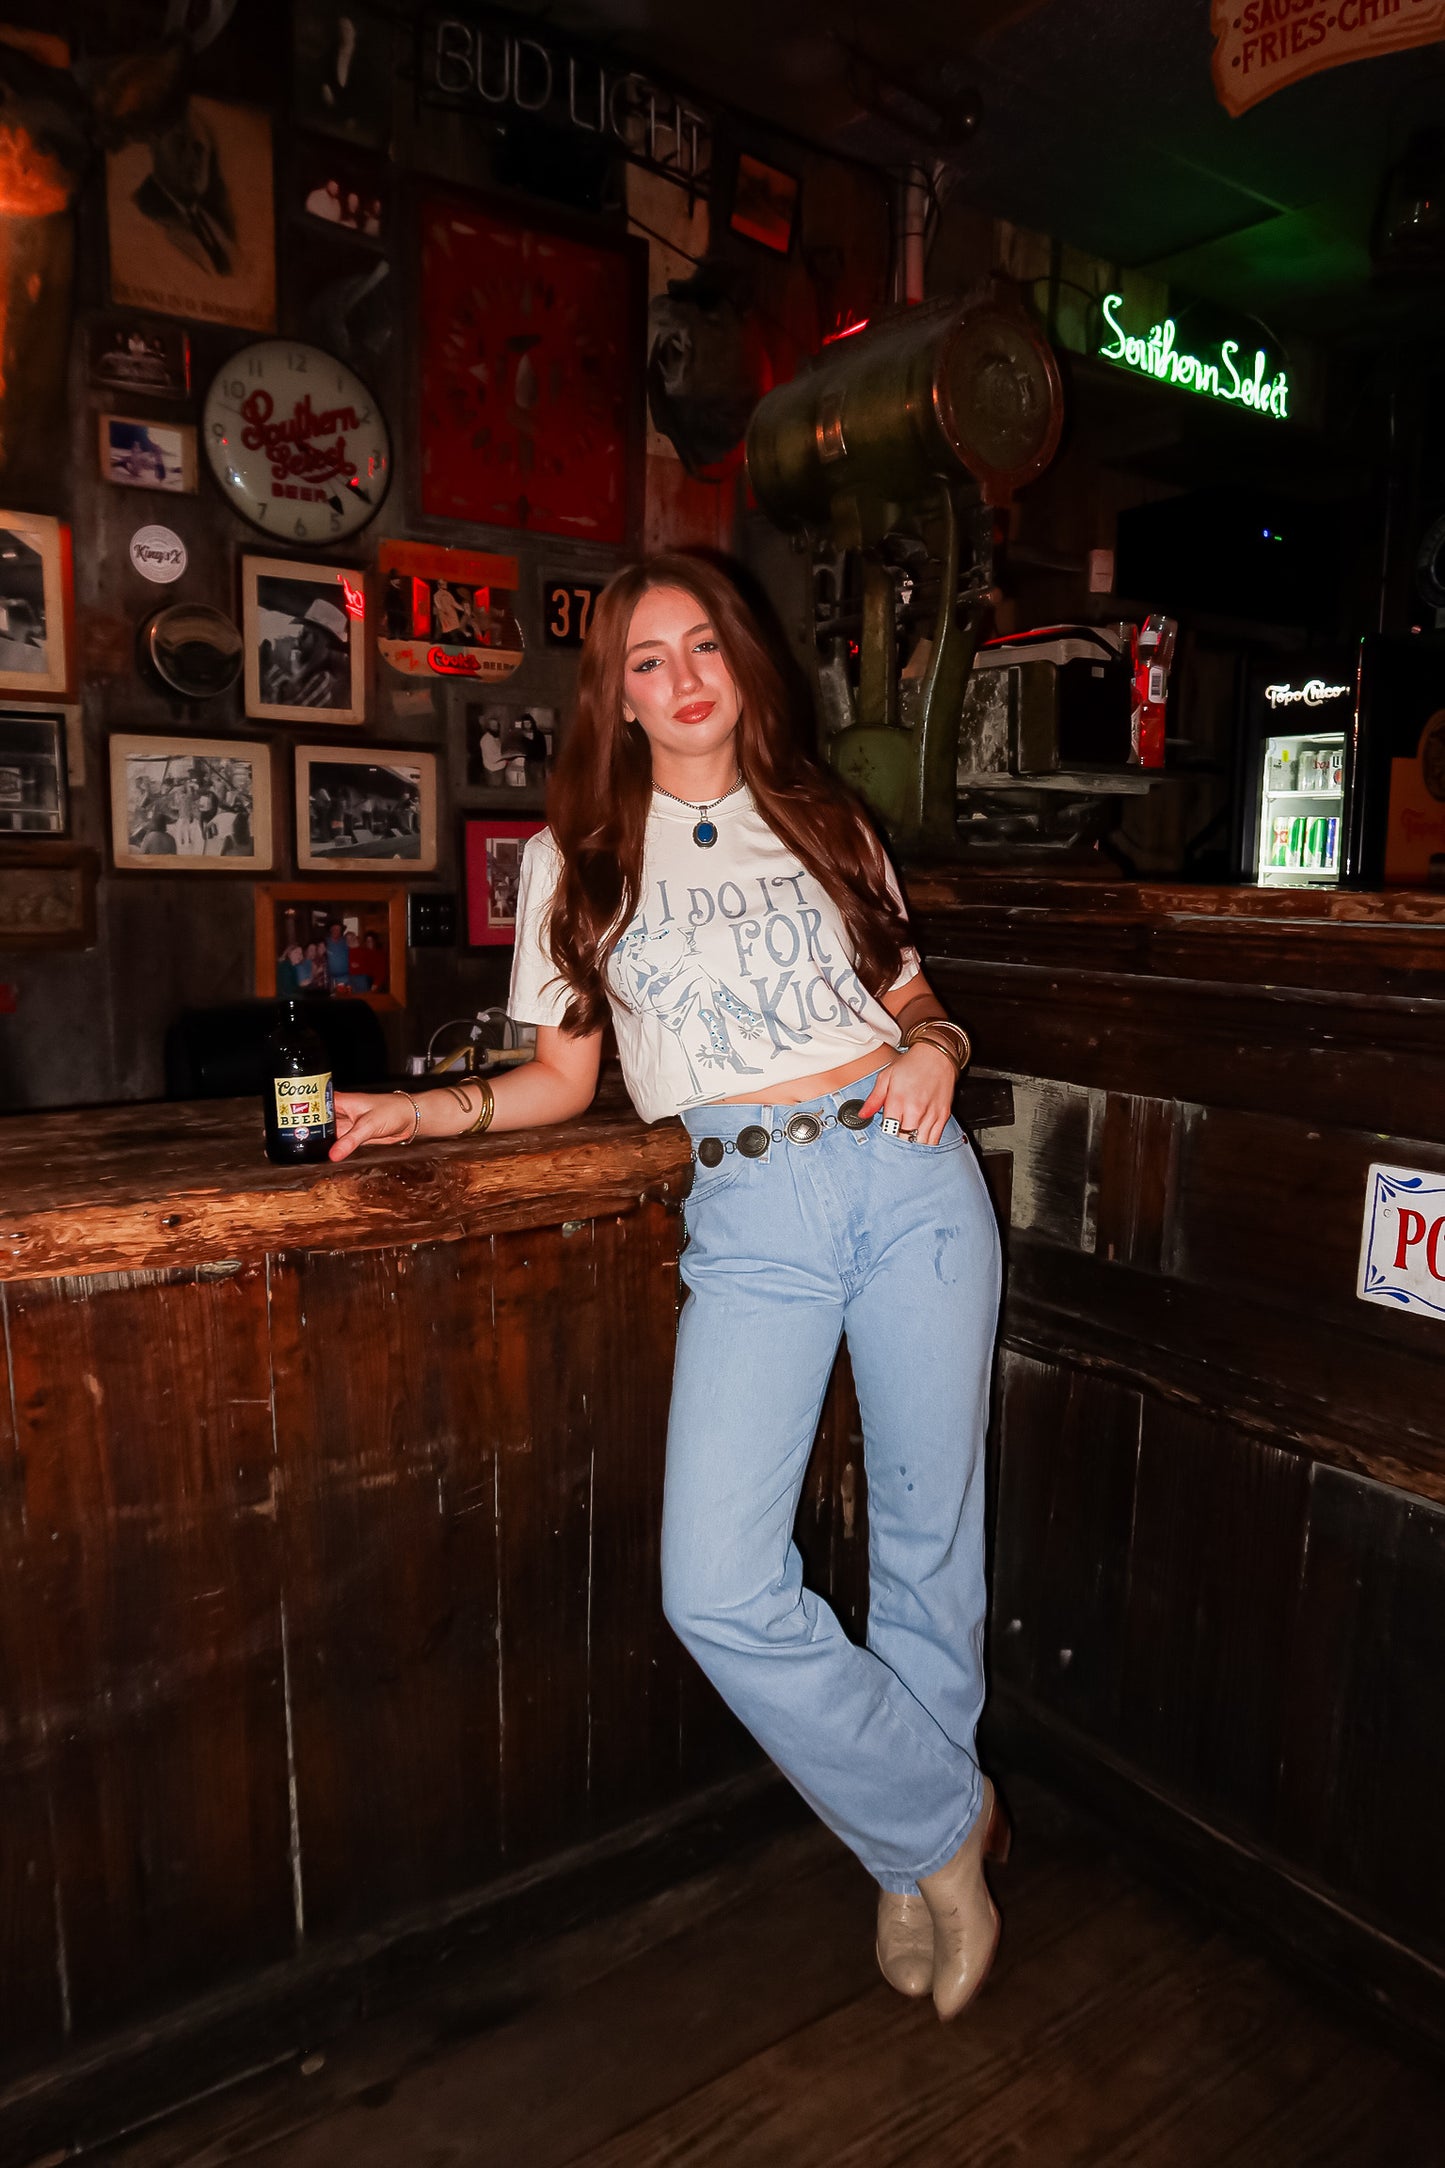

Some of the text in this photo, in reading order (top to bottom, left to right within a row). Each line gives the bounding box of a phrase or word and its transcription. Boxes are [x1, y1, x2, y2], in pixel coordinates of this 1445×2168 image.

[1243, 11, 1327, 74] FRIES
[436, 20, 705, 176] BUD LIGHT
[250, 359, 263, 378] 11
[287, 354, 307, 373] 12
[1100, 294, 1289, 419] Southern Select
[223, 379, 246, 399] 10
[241, 389, 360, 451] Southern
[271, 482, 330, 503] BEER
[257, 502, 268, 520] 7
[294, 518, 307, 537] 6
[1265, 680, 1346, 709] Topo Chico
[656, 870, 809, 928] I DO IT
[728, 908, 832, 977] FOR
[750, 966, 868, 1060] KICKS
[277, 1080, 319, 1097] Coors
[280, 1113, 322, 1126] BEER
